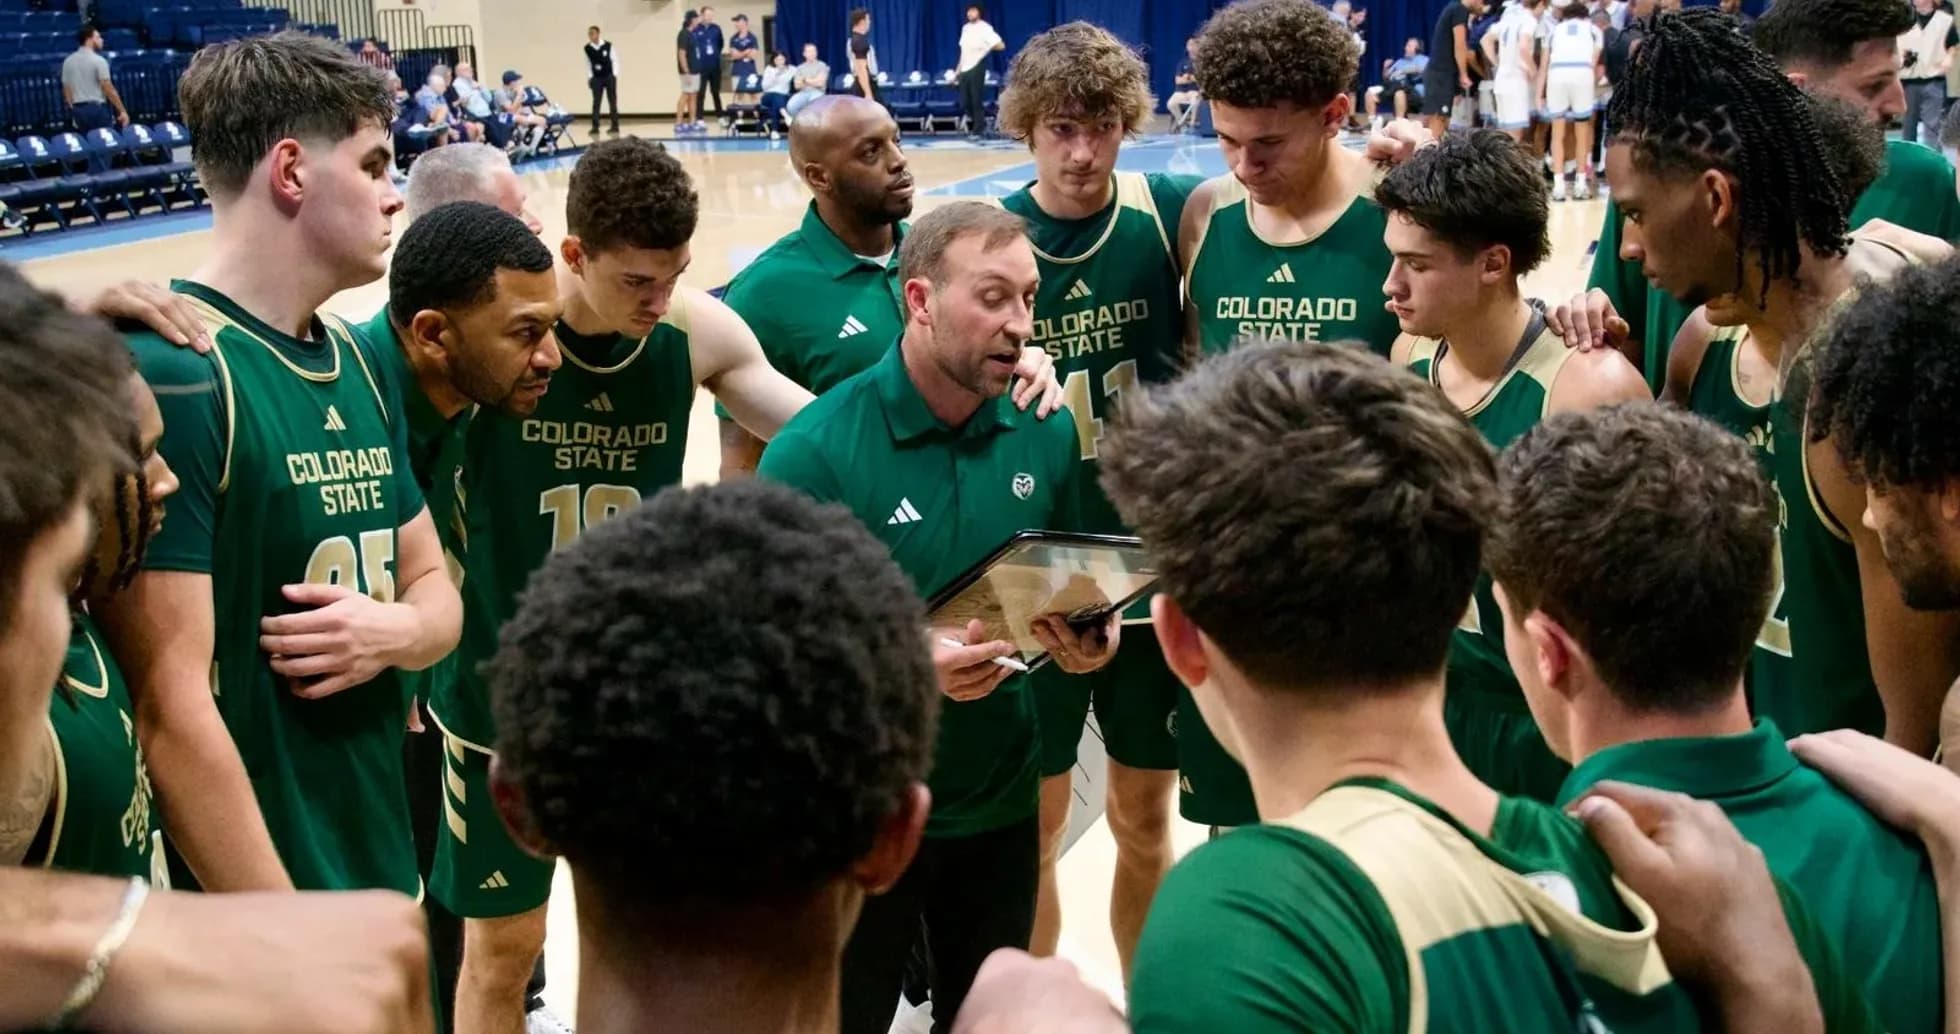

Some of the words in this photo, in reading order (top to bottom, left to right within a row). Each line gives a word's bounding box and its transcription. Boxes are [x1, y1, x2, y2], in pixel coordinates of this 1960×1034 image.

[1028, 298, 1149, 341] OLORADO
[1216, 297, 1357, 321] COLORADO
[1045, 327, 1124, 360] STATE
[1238, 321, 1321, 344] STATE
[522, 419, 667, 448] COLORADO
[286, 447, 393, 485] COLORADO
[555, 446, 638, 471] STATE
[320, 480, 384, 516] STATE
